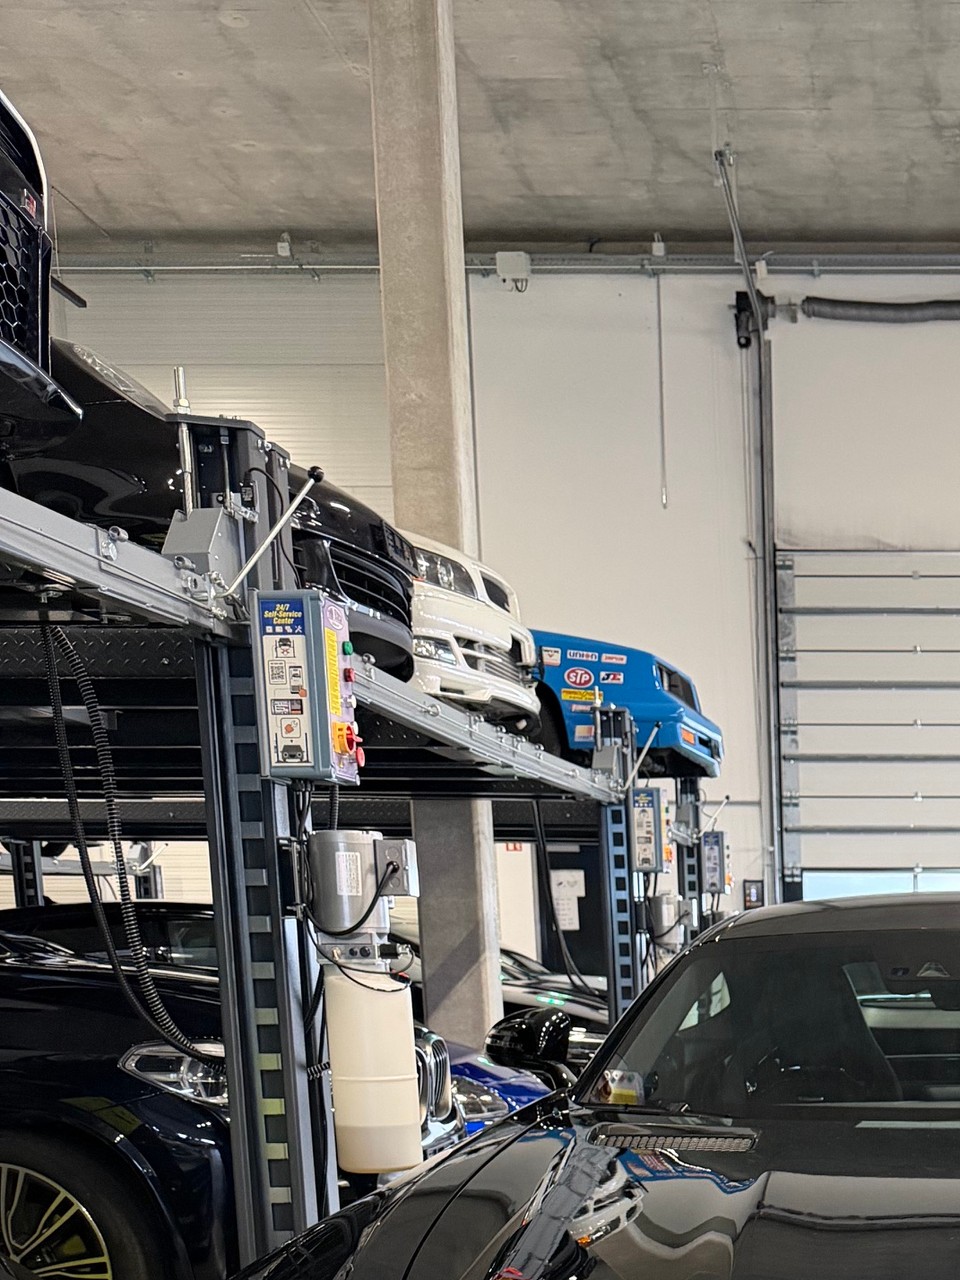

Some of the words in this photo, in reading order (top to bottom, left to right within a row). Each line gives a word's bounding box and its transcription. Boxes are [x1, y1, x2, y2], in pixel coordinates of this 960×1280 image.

[275, 603, 290, 612] 24/7
[264, 610, 302, 618] Self-Service
[273, 617, 295, 625] Center
[569, 670, 590, 684] STP
